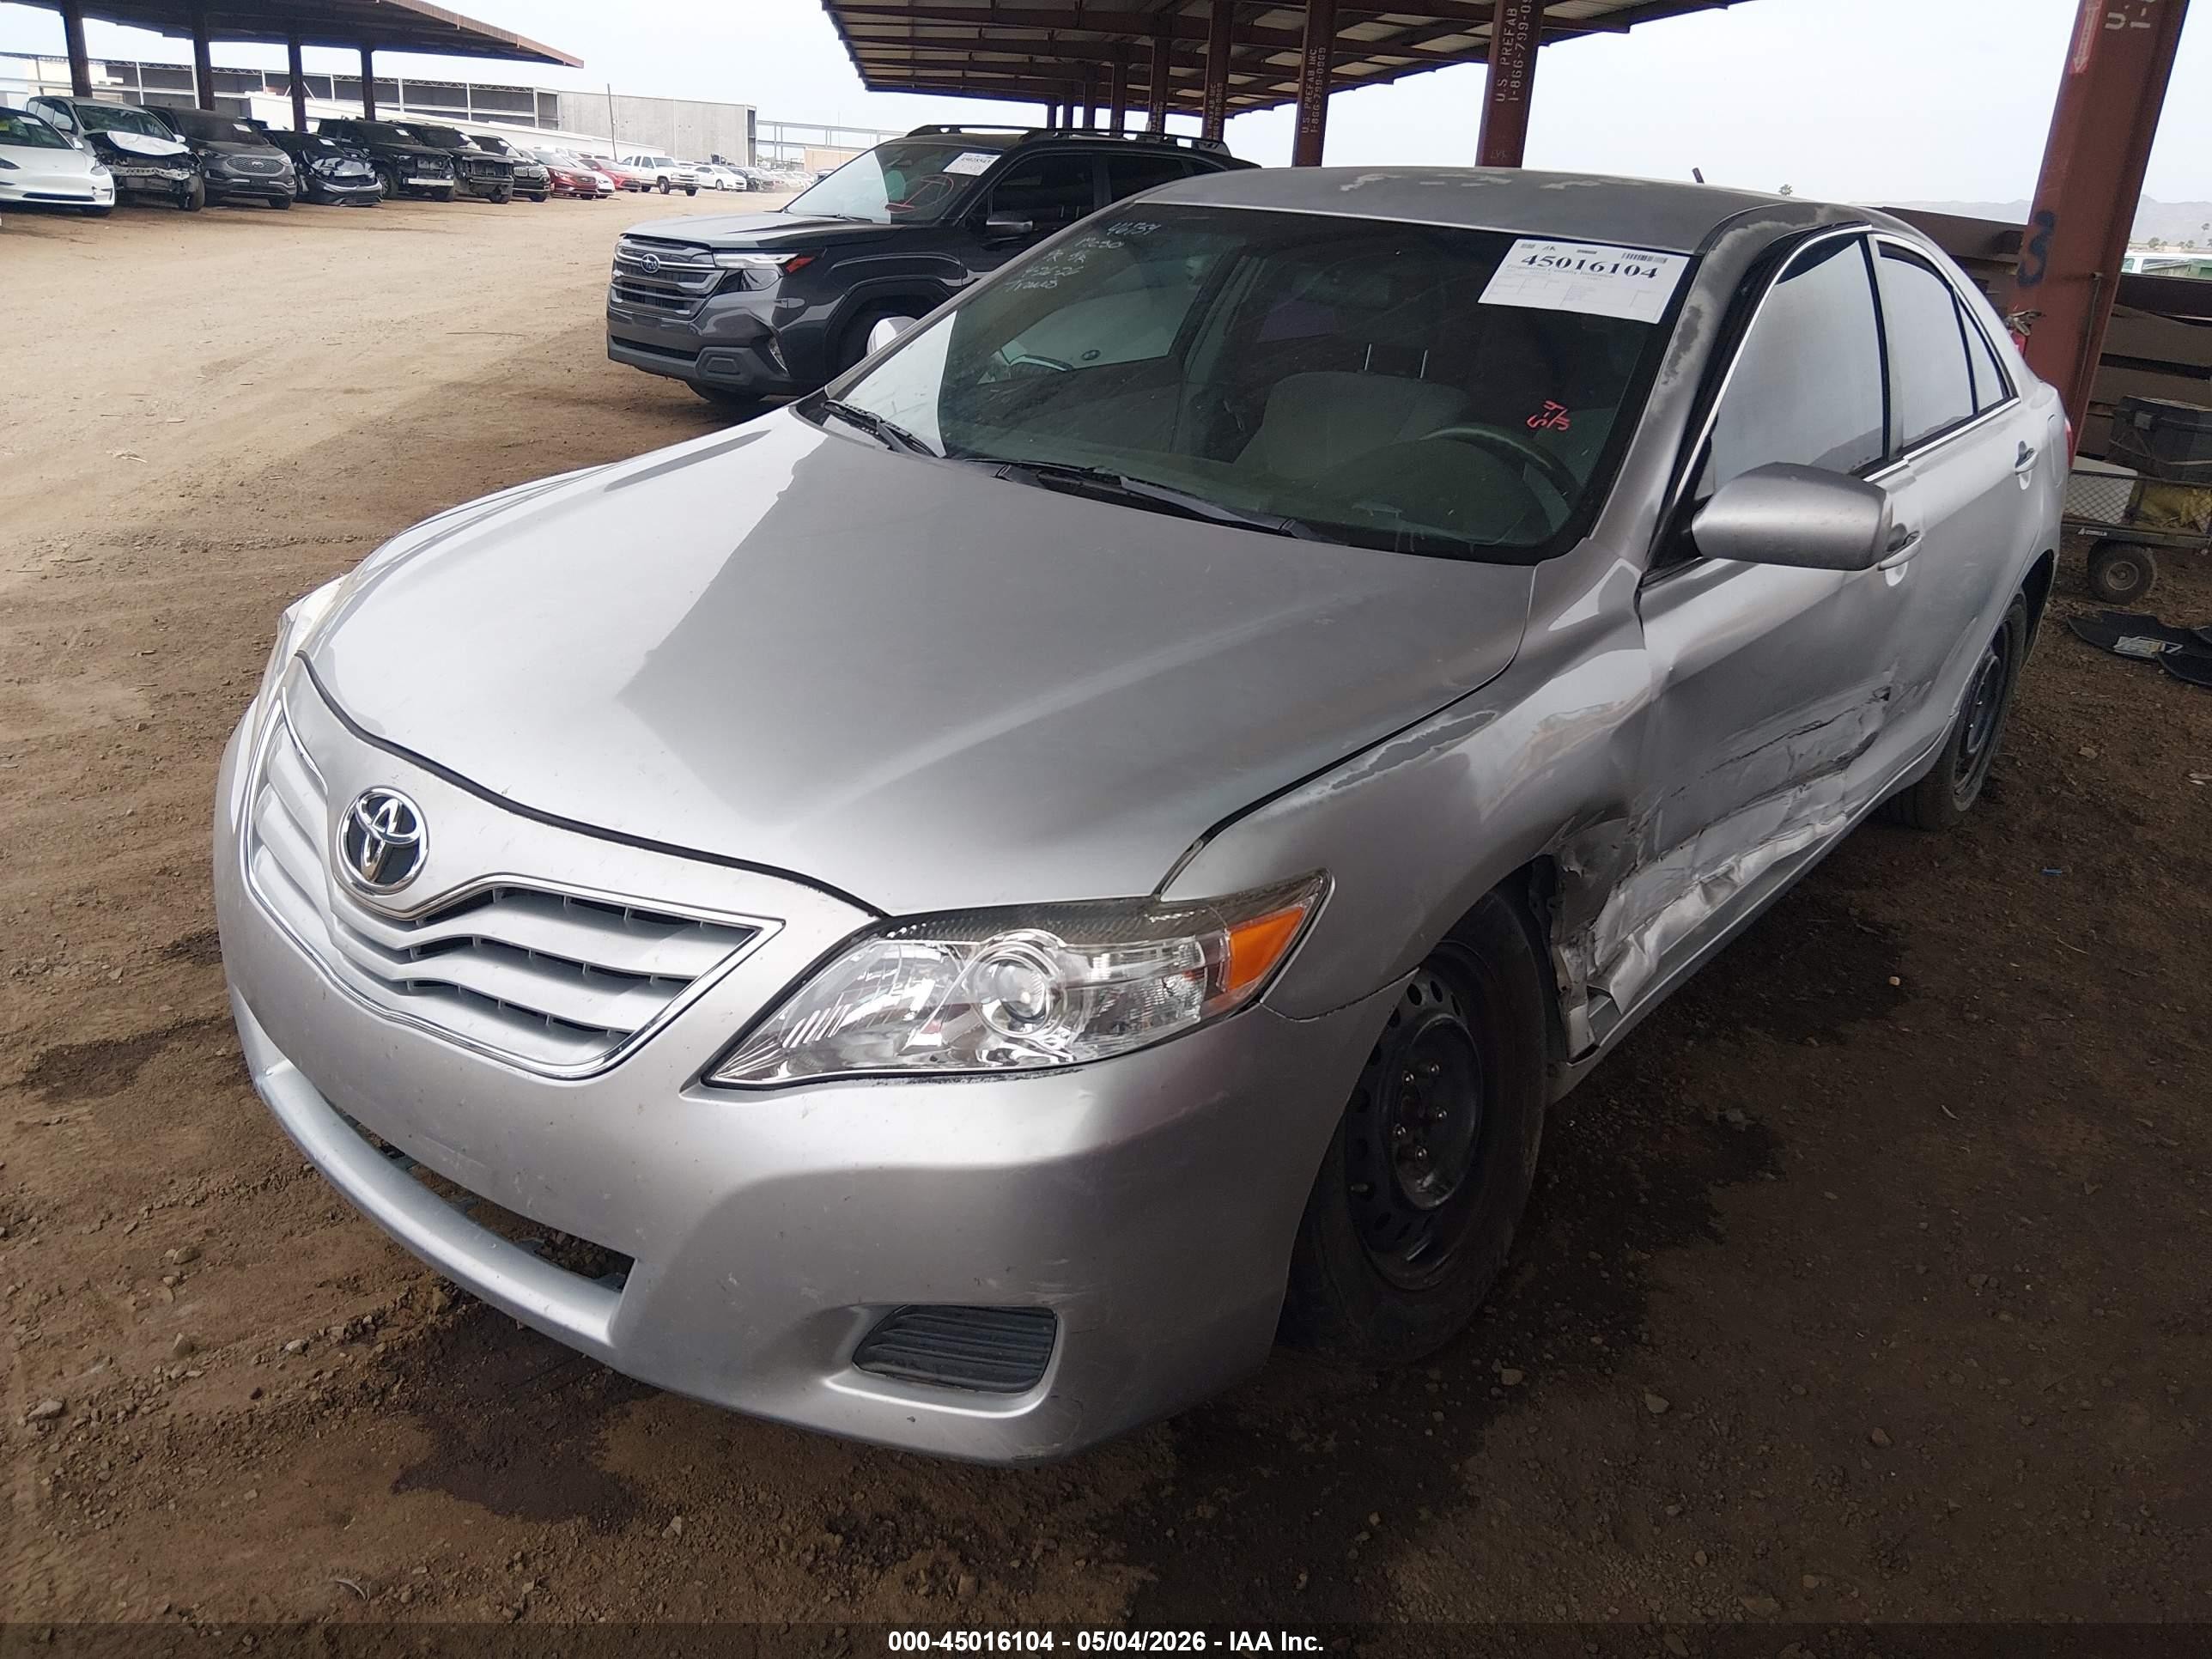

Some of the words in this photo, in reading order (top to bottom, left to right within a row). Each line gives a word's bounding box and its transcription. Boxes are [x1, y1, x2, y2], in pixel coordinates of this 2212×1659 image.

[1500, 8, 1518, 66] PREFAB
[1521, 253, 1658, 279] 45016104
[2017, 210, 2056, 287] 3
